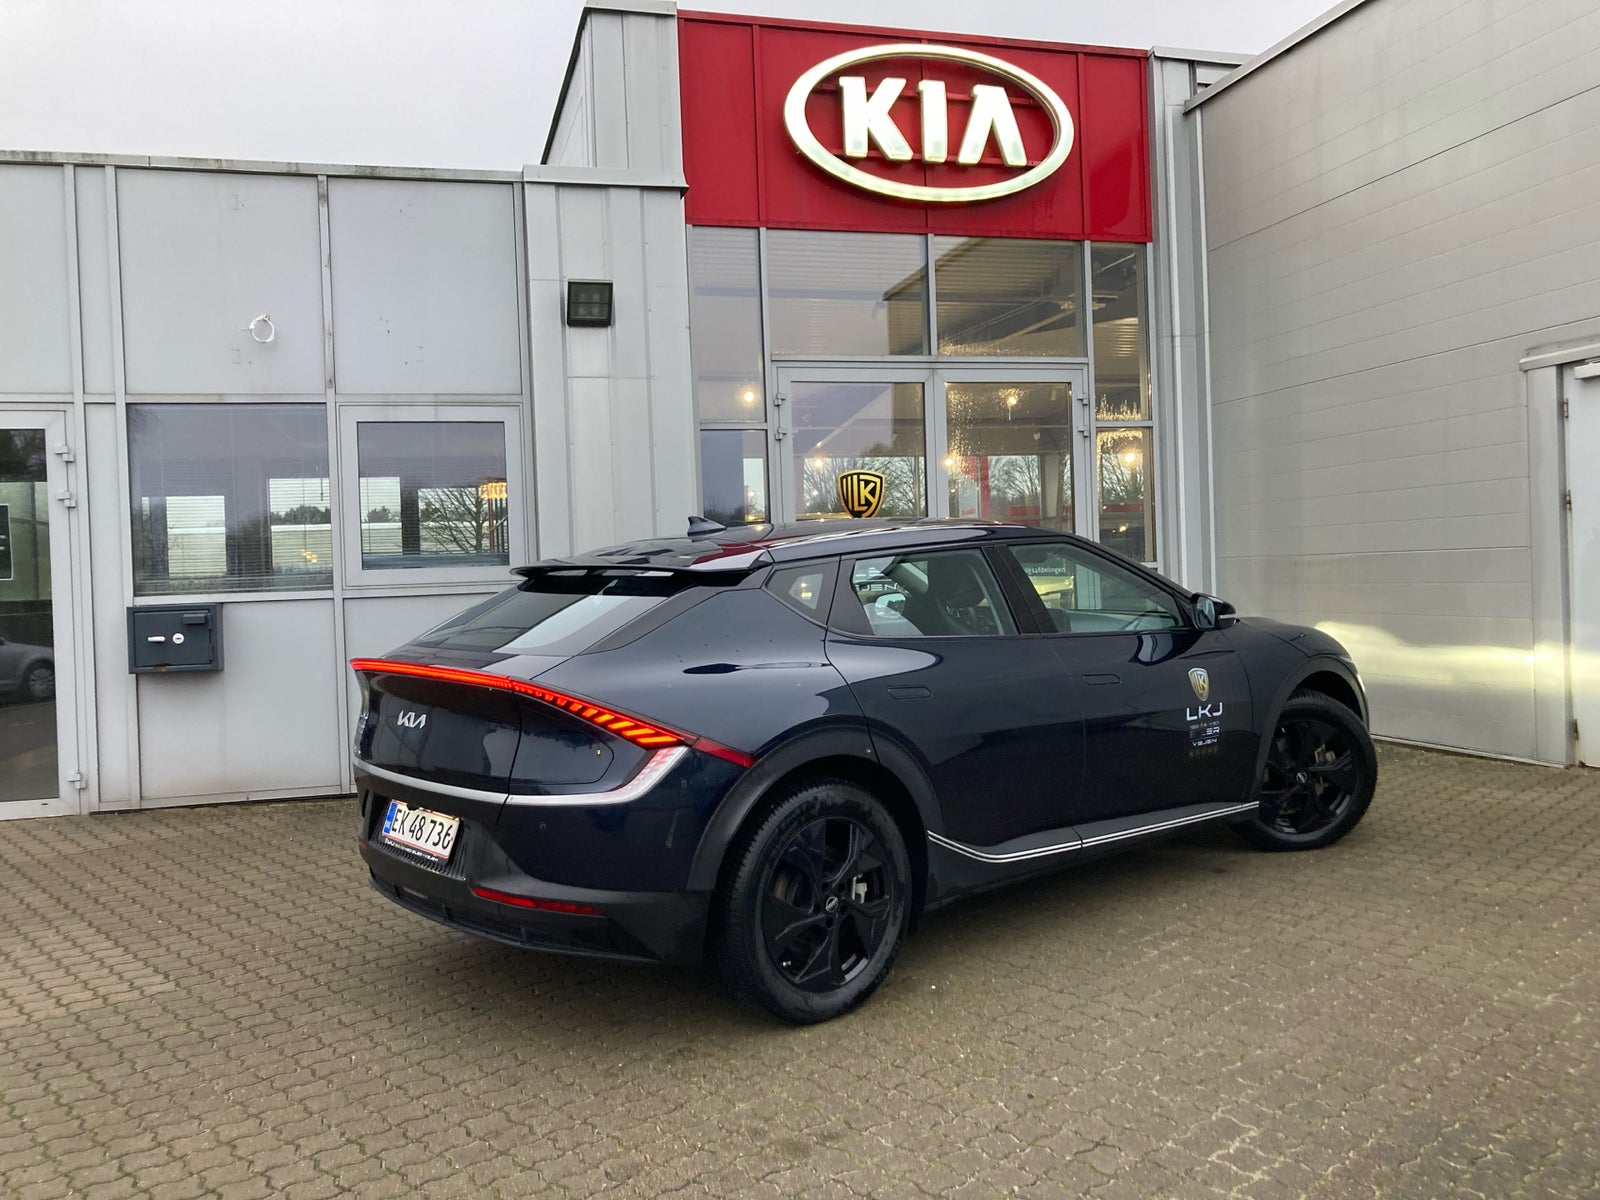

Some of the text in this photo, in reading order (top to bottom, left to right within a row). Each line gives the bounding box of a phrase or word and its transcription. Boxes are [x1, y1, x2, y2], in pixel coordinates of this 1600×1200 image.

[838, 76, 1028, 167] KIA
[397, 709, 427, 730] KIA
[1186, 702, 1223, 721] LKJ
[391, 808, 410, 836] EK
[409, 814, 426, 841] 48
[425, 819, 453, 850] 736
